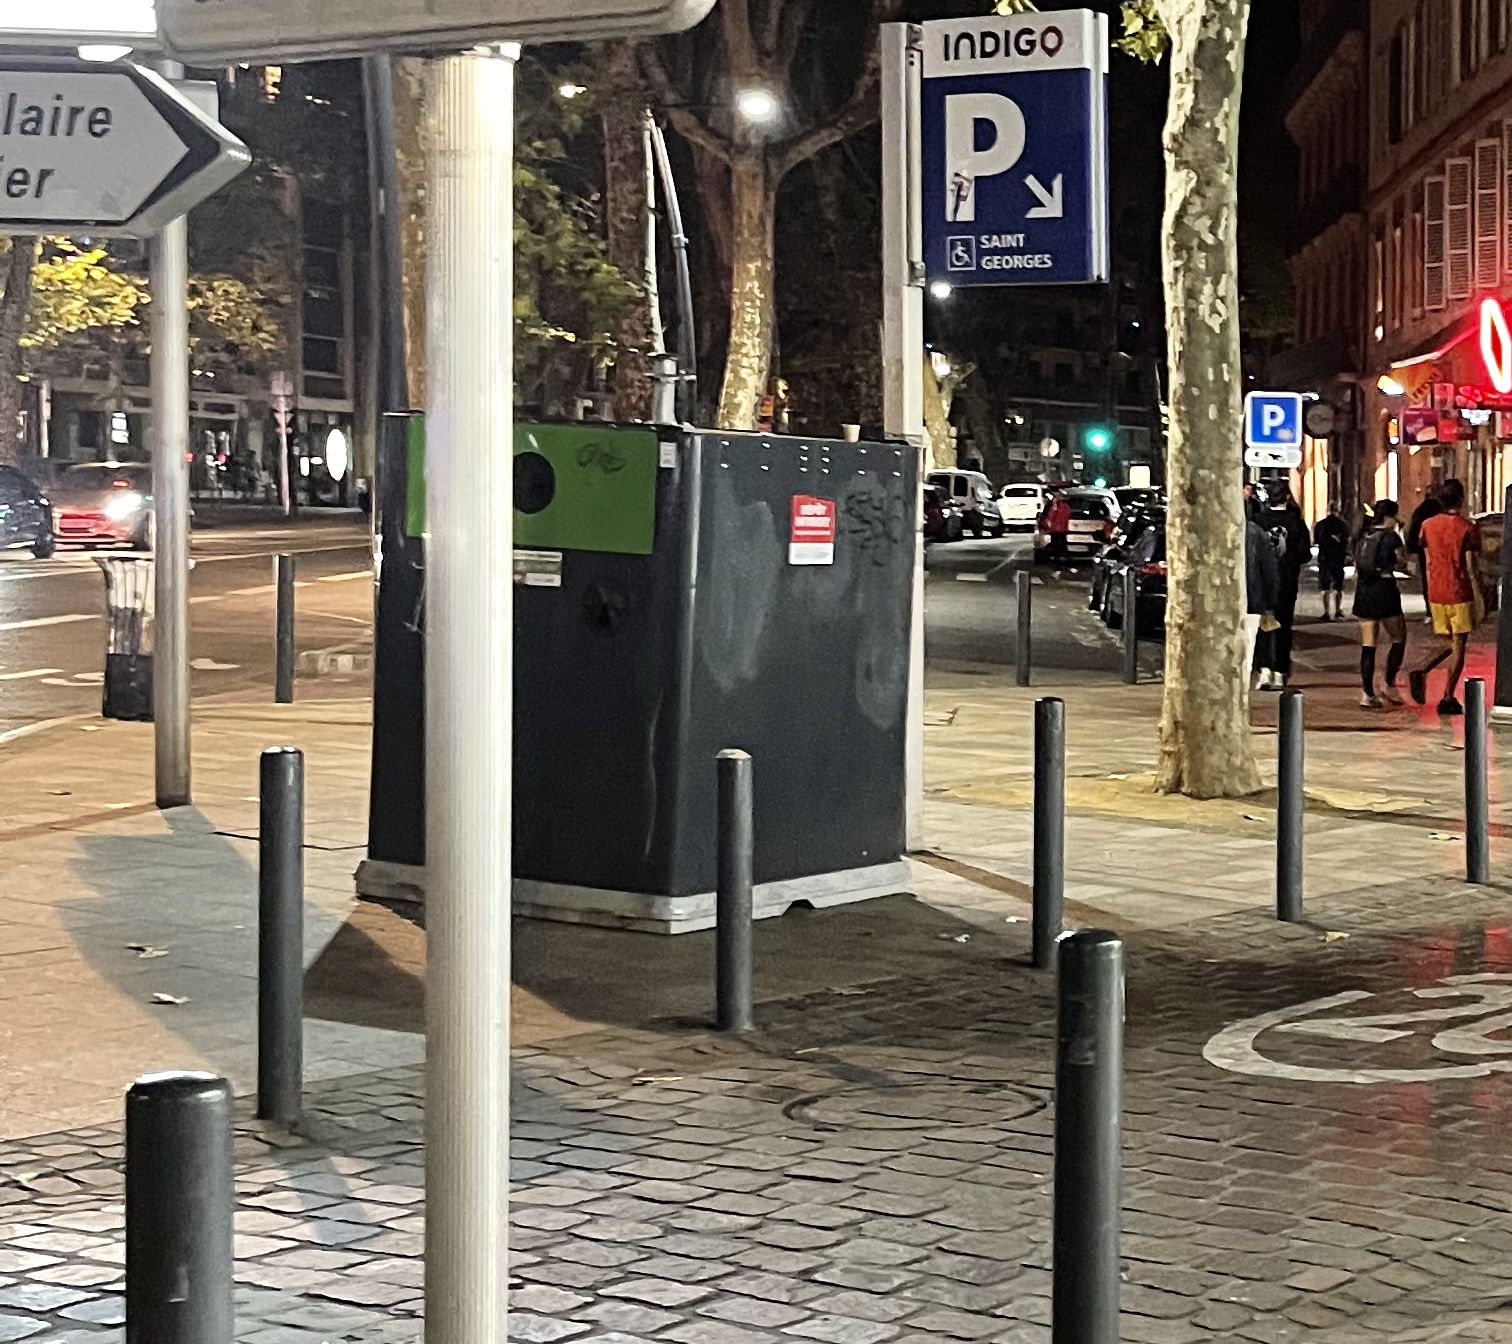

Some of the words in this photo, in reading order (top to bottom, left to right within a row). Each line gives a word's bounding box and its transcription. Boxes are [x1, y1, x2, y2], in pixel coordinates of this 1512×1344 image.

[944, 25, 1064, 61] INDIGO
[945, 92, 1026, 222] P
[0, 155, 55, 199] er
[980, 233, 1025, 249] SAINT
[980, 254, 1052, 269] GEORGES
[1263, 404, 1286, 436] P
